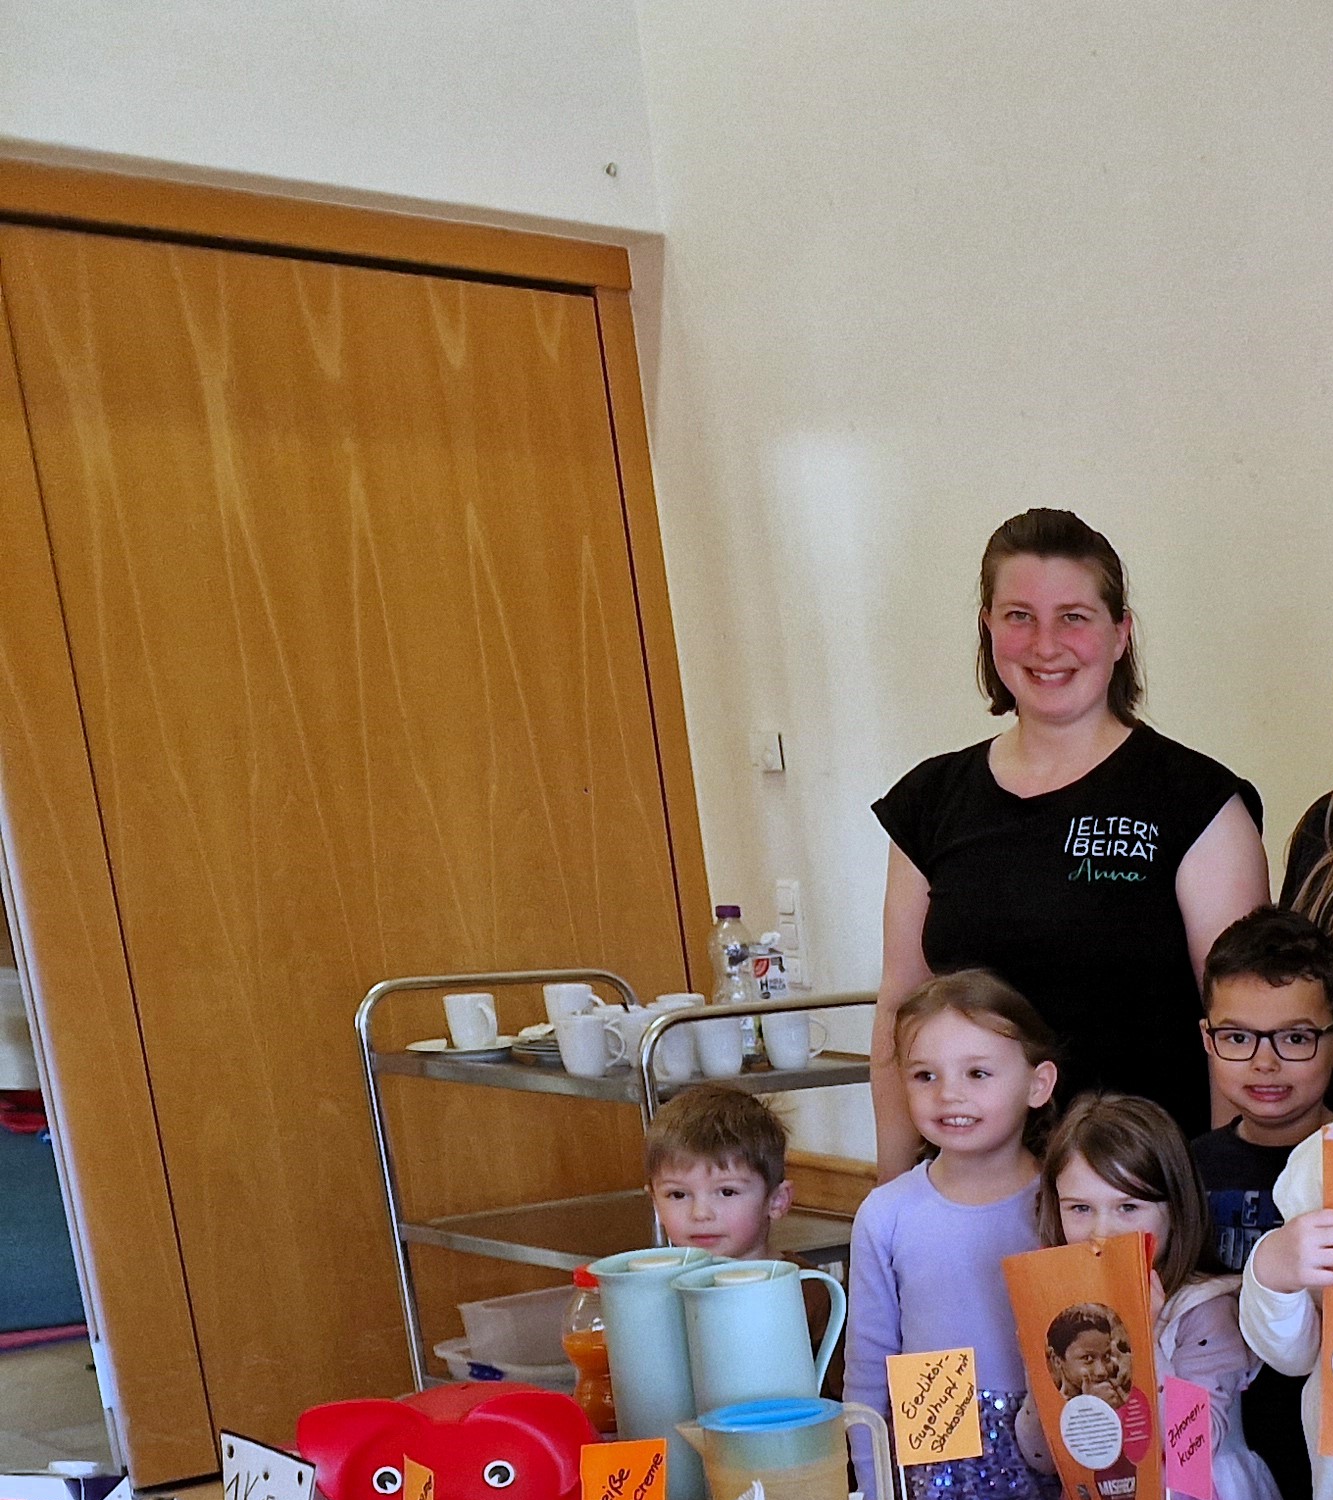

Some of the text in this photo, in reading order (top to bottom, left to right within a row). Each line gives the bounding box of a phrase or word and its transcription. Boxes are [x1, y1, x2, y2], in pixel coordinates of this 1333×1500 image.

[1077, 816, 1159, 841] ELTERN
[1072, 838, 1158, 862] BEIRAT
[1068, 857, 1146, 882] Anna
